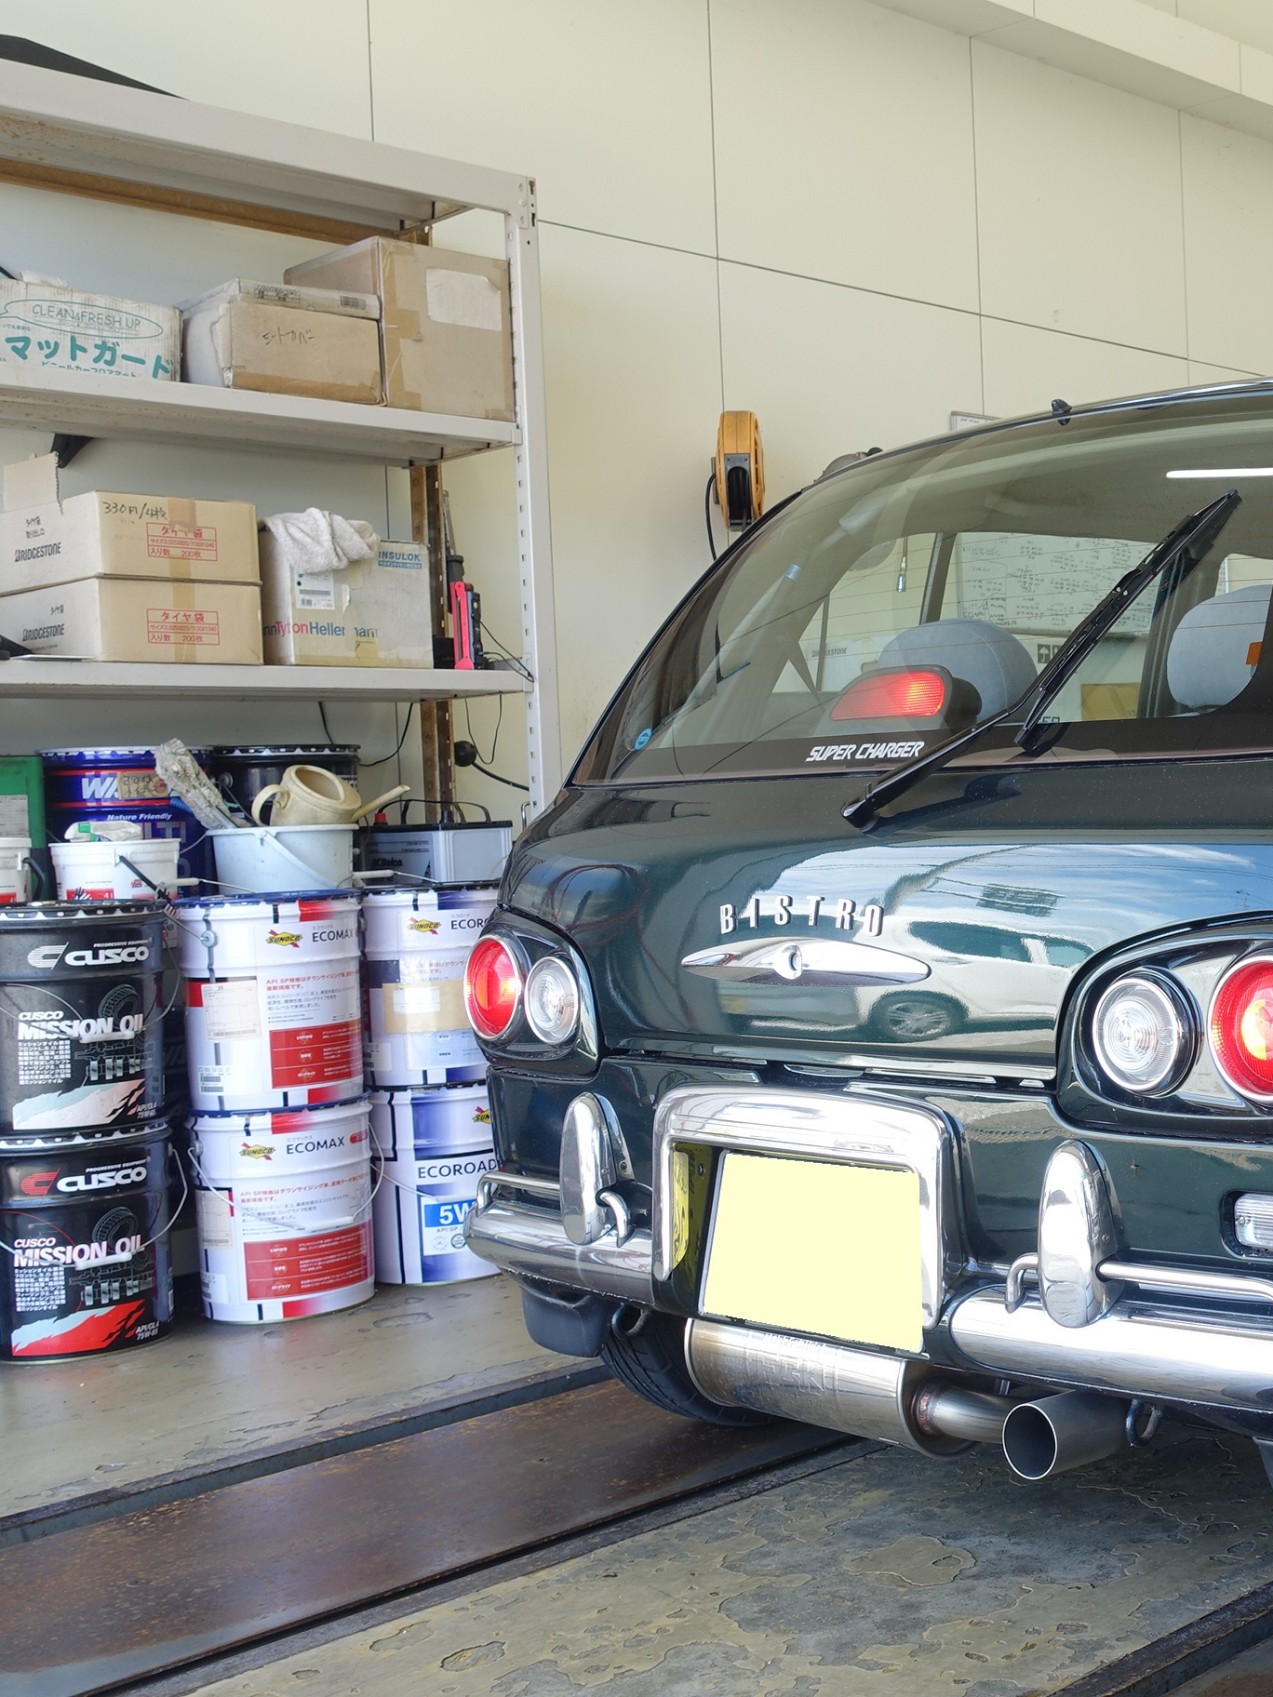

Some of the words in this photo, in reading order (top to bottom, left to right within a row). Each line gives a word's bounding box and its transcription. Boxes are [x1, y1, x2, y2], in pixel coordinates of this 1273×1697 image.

[32, 304, 75, 320] CLEAN
[82, 311, 122, 328] FRESH
[125, 319, 141, 329] UP
[5, 335, 174, 379] マットガード
[14, 542, 62, 563] BRIDGESTONE
[378, 551, 420, 562] INSULOK
[22, 624, 65, 643] BRIDGESTONE
[805, 744, 857, 762] SUPER
[855, 741, 925, 760] CHARGER
[138, 812, 172, 822] Friendly
[451, 918, 489, 930] ECOR
[719, 895, 885, 937] BISTRO
[267, 932, 302, 944] SUNOCO
[312, 928, 354, 943] ECOMAX
[65, 946, 150, 966] CUSCO
[18, 1011, 64, 1021] CUSCO
[18, 1017, 114, 1041] MISSION
[120, 1013, 147, 1032] OIL
[240, 1147, 274, 1157] SUNOCO
[286, 1136, 346, 1155] ECOMAX
[57, 1166, 147, 1192] CUSCO
[418, 1158, 497, 1179] ECOROAD
[439, 1202, 477, 1225] 5W
[14, 1237, 56, 1248] CUSCO
[14, 1241, 108, 1267] MISSION
[115, 1234, 145, 1254] OIL
